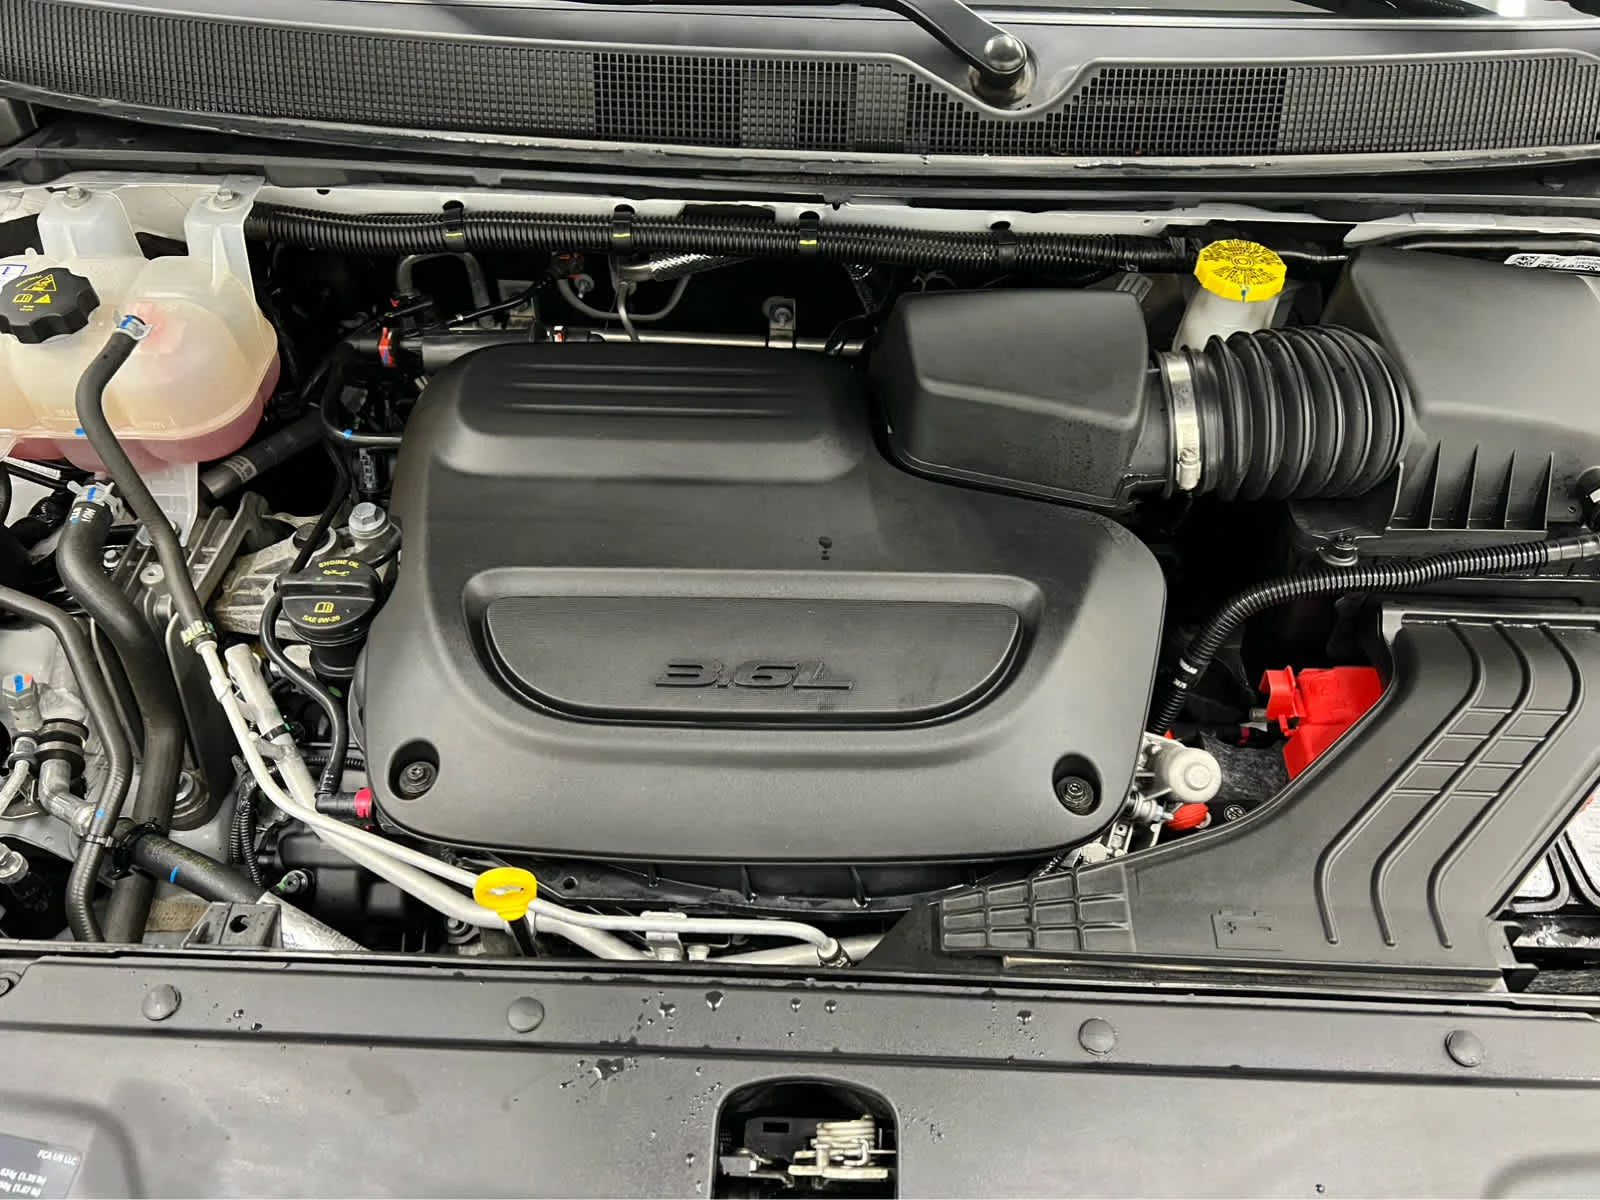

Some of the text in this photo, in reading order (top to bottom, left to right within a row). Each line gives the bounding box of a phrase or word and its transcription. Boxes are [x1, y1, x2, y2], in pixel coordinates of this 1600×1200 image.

[318, 559, 359, 568] ENGINE OIL
[302, 614, 317, 623] SAE
[654, 657, 855, 690] 3.6L
[36, 1149, 78, 1166] FCA US LLC
